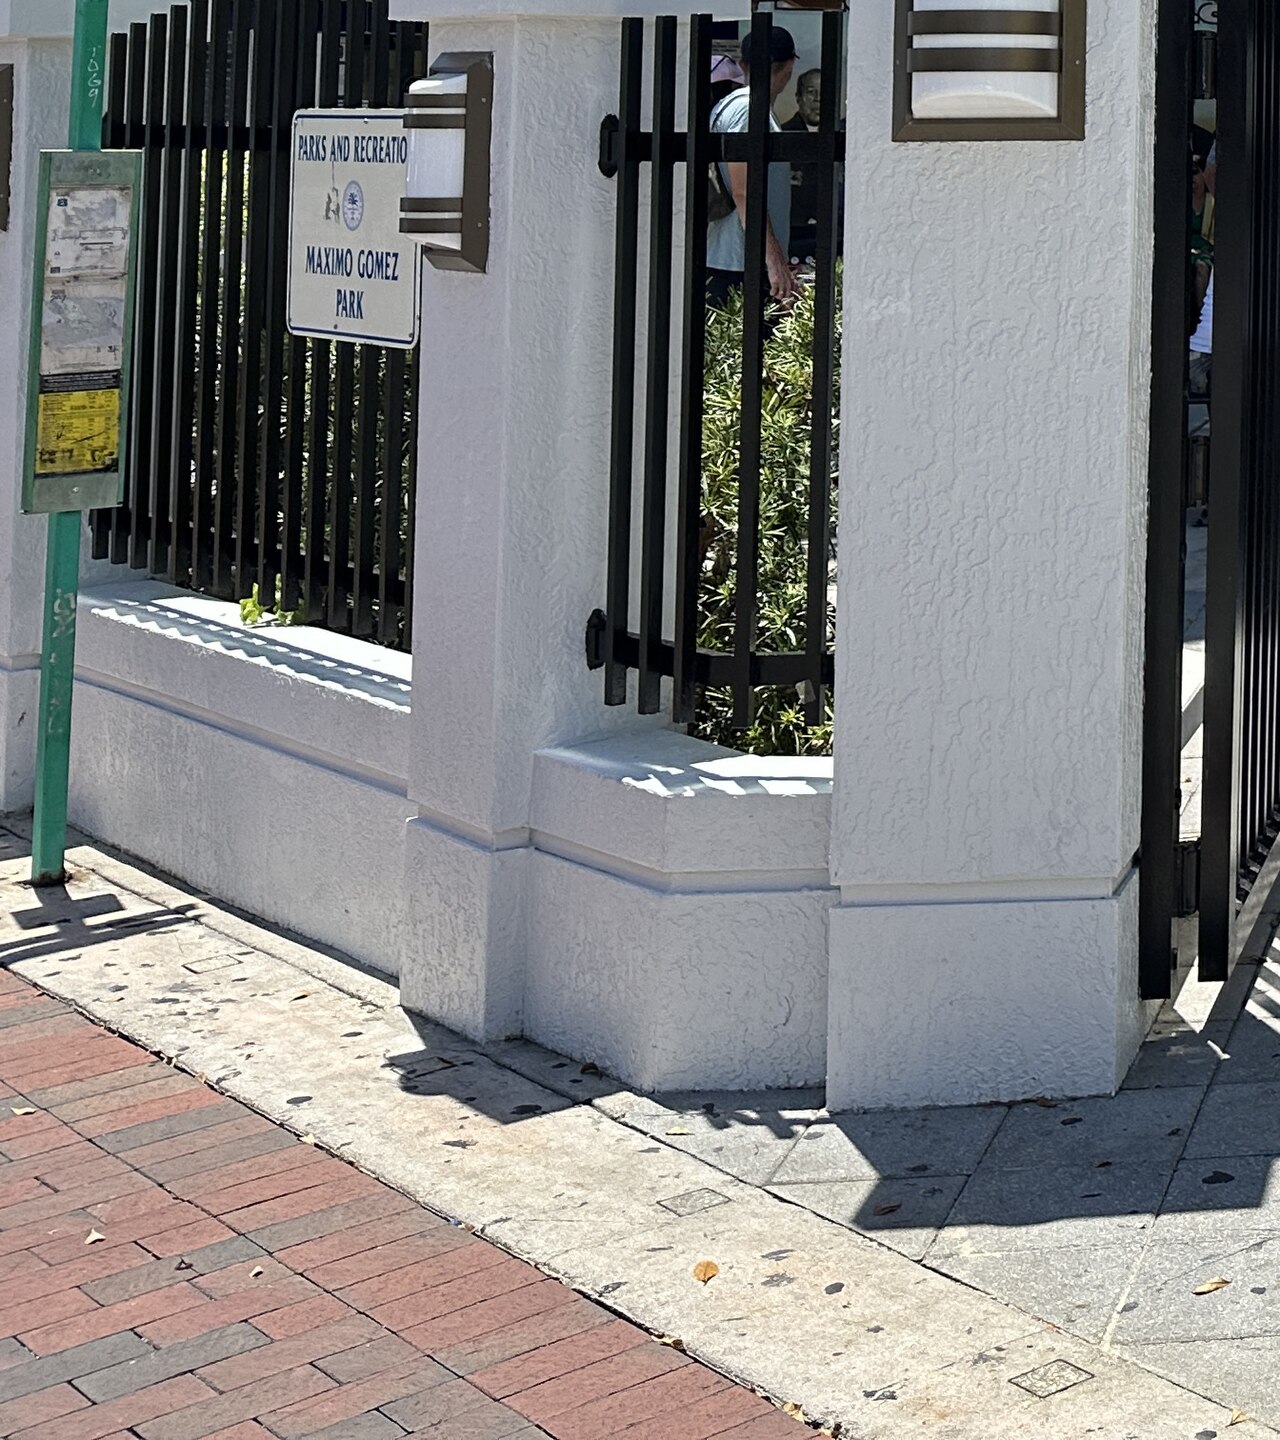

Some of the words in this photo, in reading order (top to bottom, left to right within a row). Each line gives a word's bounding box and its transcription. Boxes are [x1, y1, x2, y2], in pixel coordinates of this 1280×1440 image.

[298, 134, 327, 162] PARKS
[330, 135, 350, 162] AND
[353, 135, 408, 164] RECREATIO
[305, 245, 353, 277] MAXIMO
[357, 249, 399, 281] GOMEZ
[335, 288, 364, 320] PARK
